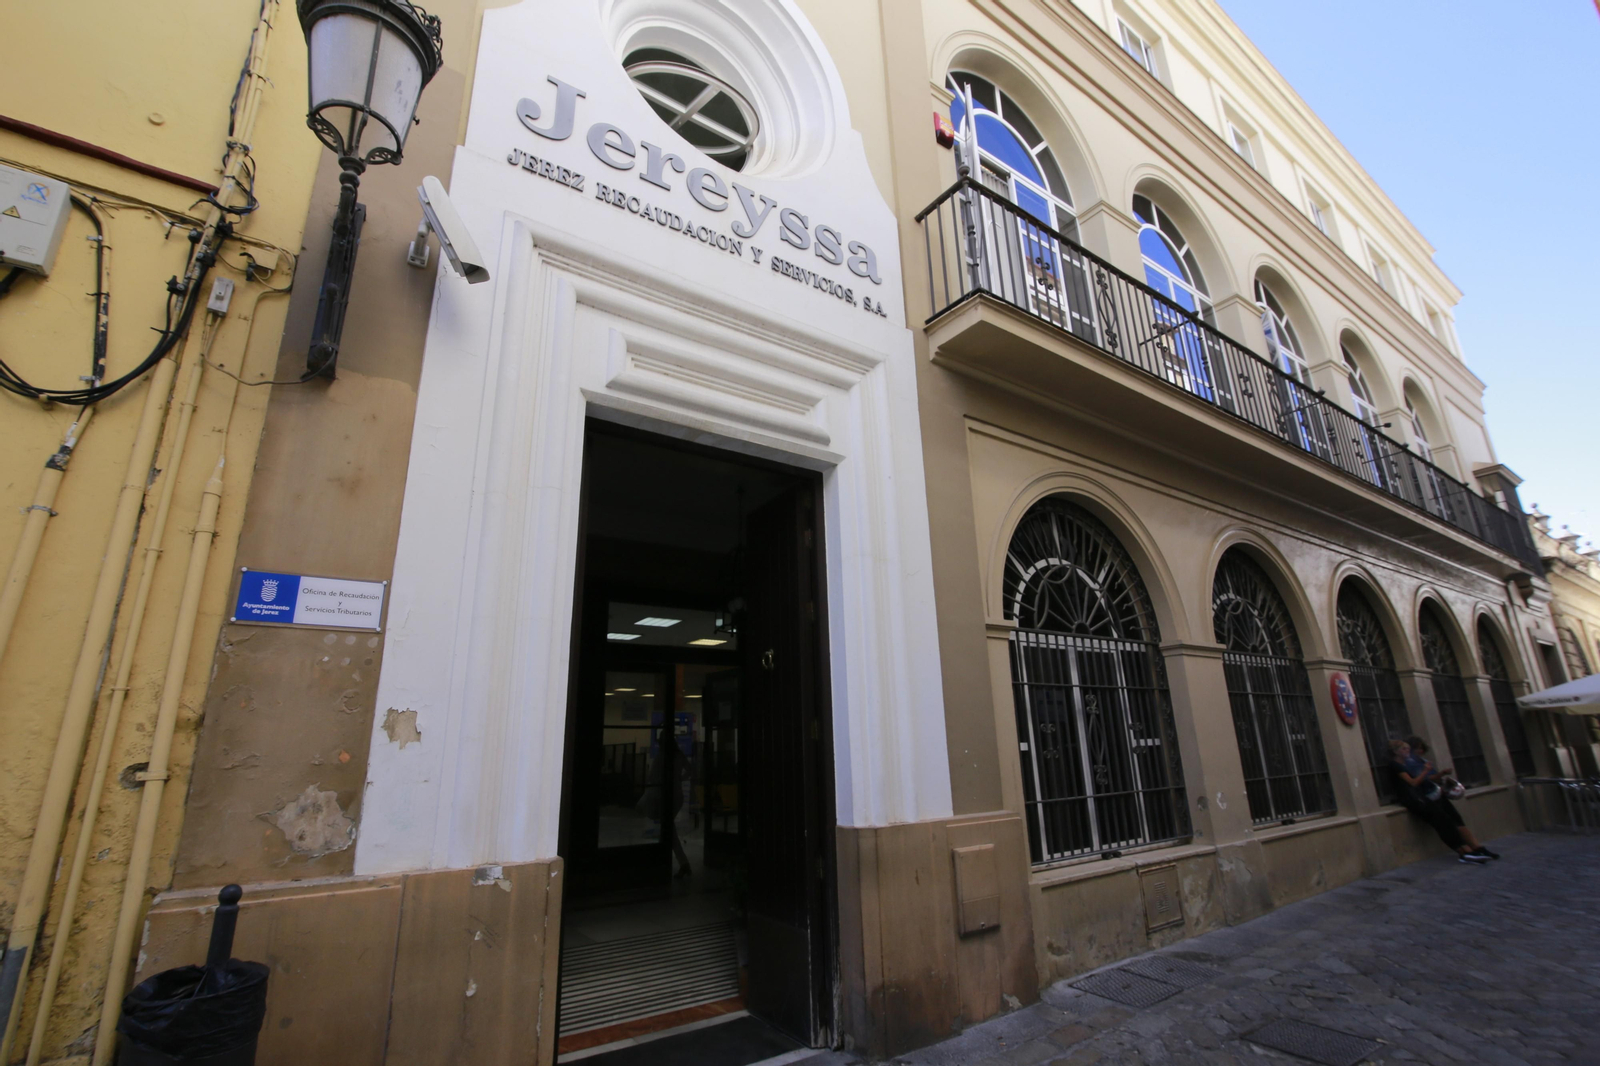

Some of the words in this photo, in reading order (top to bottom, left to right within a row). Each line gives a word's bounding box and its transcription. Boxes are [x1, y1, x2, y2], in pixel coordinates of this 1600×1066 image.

[516, 75, 882, 285] Jereyssa
[507, 147, 585, 193] JEREZ
[595, 182, 743, 257] RECAUDACION
[751, 245, 764, 265] Y
[771, 255, 858, 309] SERVICIOS,
[863, 295, 888, 319] S.A.
[302, 588, 327, 596] Oficina
[242, 602, 290, 611] Ayuntamiento
[305, 605, 336, 614] Servicios
[336, 607, 372, 616] Tributarios
